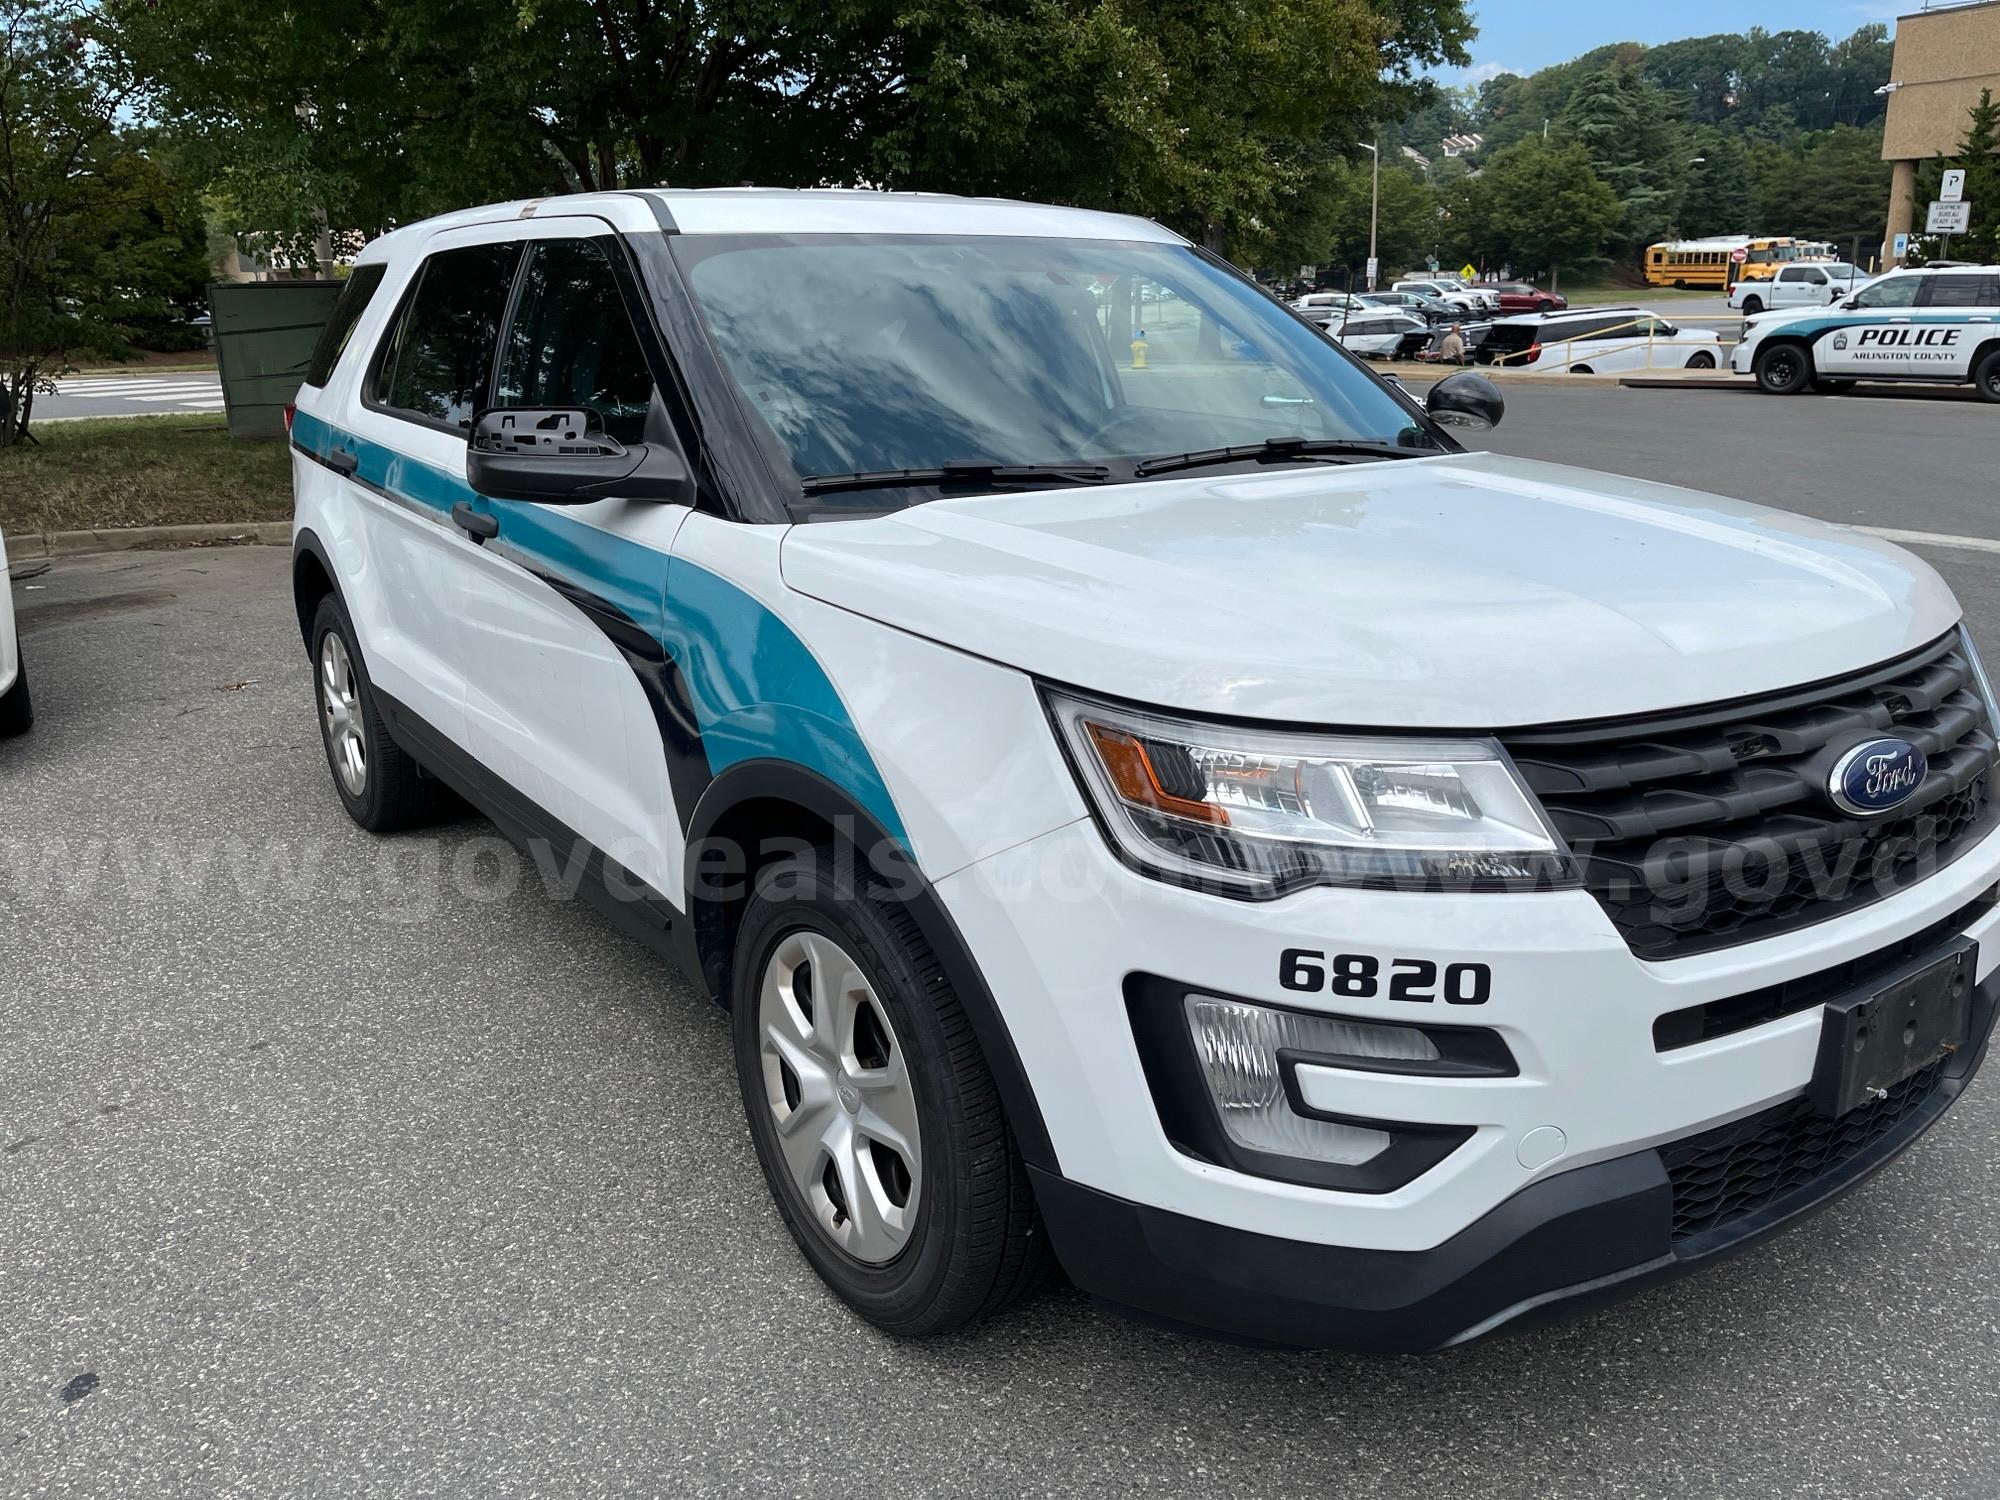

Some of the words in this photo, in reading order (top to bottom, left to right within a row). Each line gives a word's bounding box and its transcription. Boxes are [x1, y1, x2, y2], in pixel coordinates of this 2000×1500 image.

[1858, 329, 1961, 346] POLICE
[1852, 352, 1911, 361] ARLINGTON
[1914, 352, 1957, 361] COUNTY
[1866, 751, 1916, 799] Ford
[1279, 948, 1491, 1005] 6820
